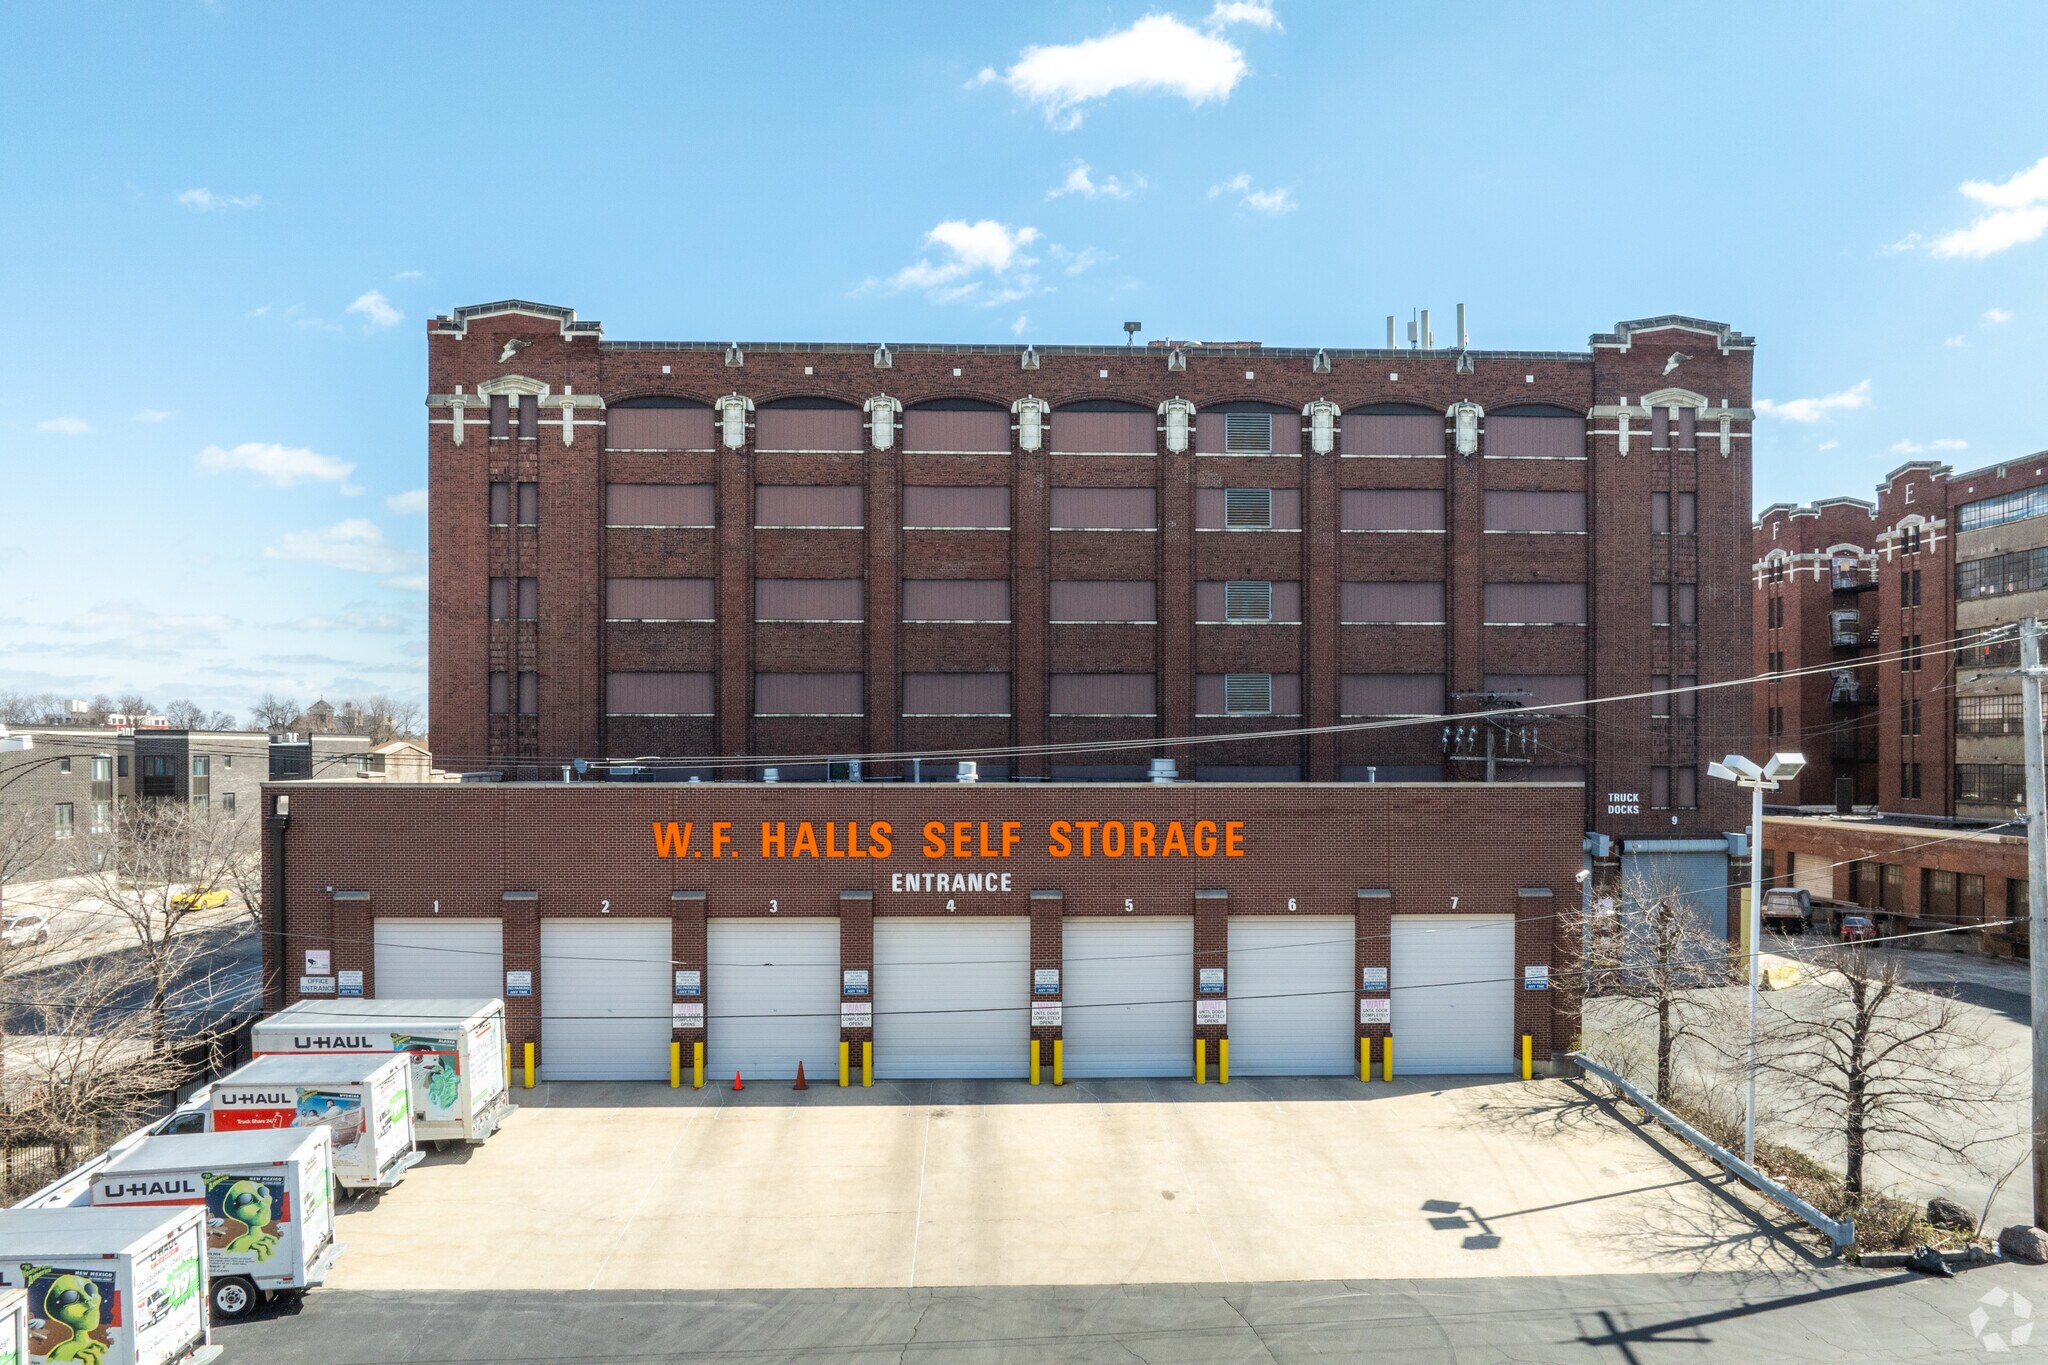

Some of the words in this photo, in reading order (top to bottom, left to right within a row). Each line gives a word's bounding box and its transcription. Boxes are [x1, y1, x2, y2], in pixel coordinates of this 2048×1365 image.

[1904, 482, 1916, 504] E
[1772, 520, 1780, 540] F
[1608, 793, 1639, 802] TRUCK
[1608, 806, 1639, 814] DOCKS
[1672, 816, 1678, 825] 9
[762, 821, 893, 859] HALLS
[922, 821, 1021, 858] SELF
[1048, 820, 1244, 858] STORAGE
[891, 872, 1012, 893] ENTRANCE
[433, 900, 439, 913] 1
[601, 900, 610, 913] 2
[769, 899, 778, 913] 3
[946, 899, 957, 912] 4
[1124, 898, 1134, 912] 5
[1288, 898, 1297, 912] 6
[1450, 896, 1459, 910] 7
[1365, 1000, 1385, 1008] WAIT
[294, 1036, 373, 1049] U-HAUL
[222, 1093, 291, 1104] U-HAUL
[104, 1180, 196, 1198] U-HAUL
